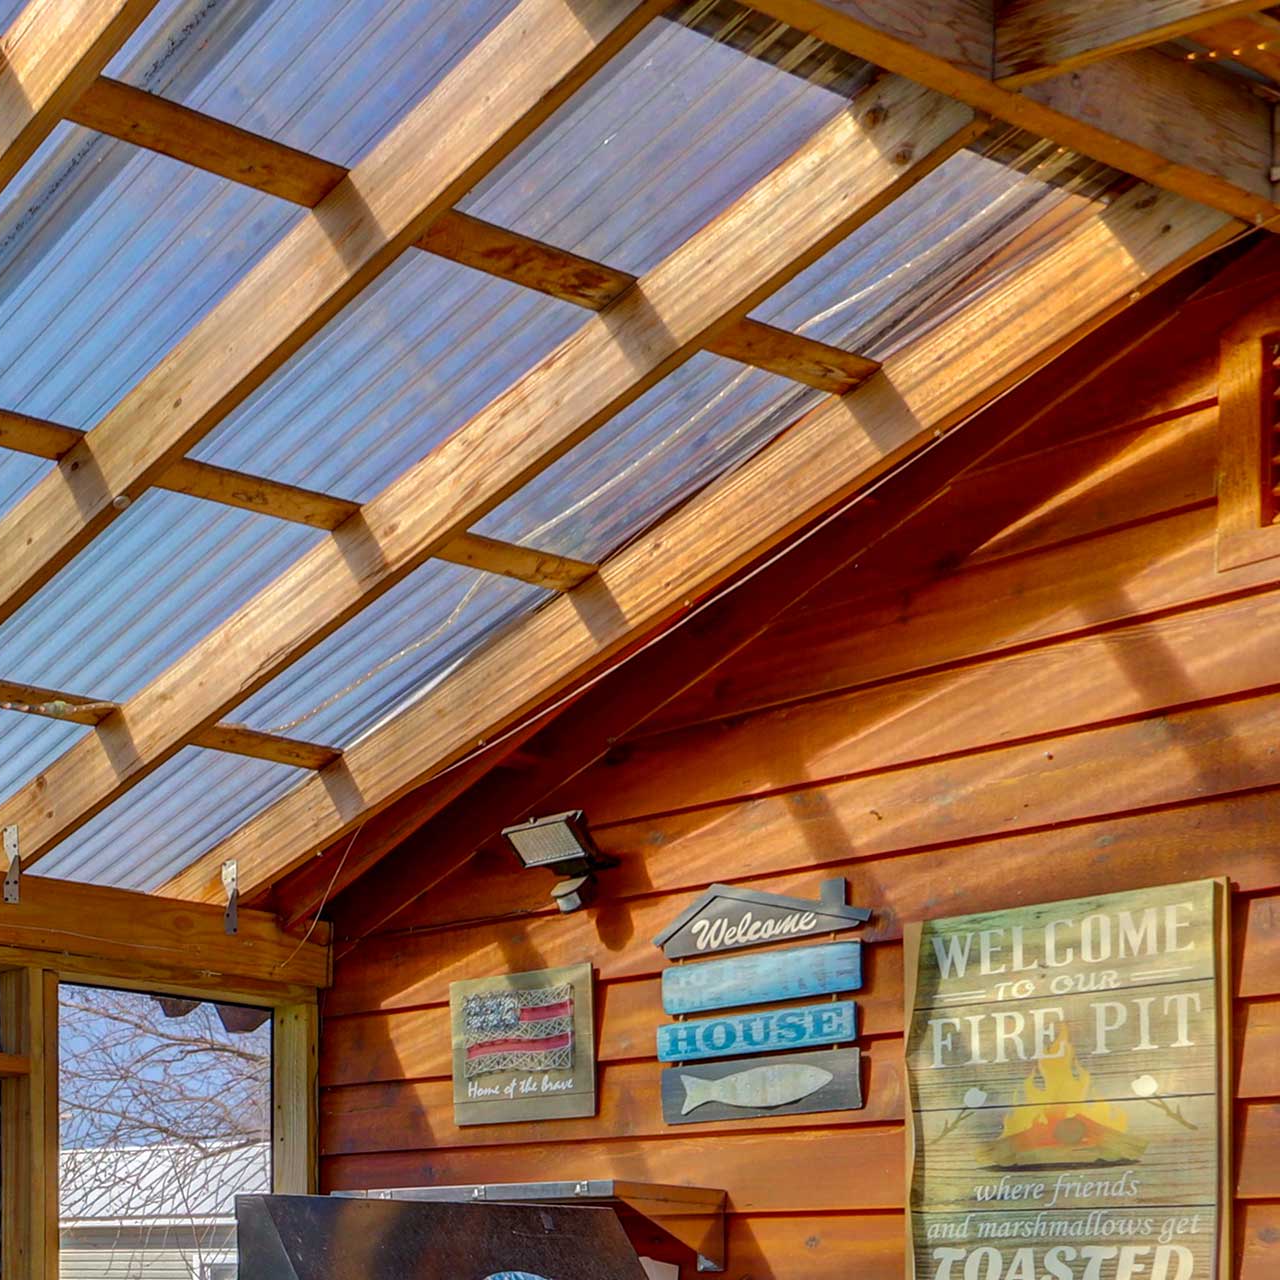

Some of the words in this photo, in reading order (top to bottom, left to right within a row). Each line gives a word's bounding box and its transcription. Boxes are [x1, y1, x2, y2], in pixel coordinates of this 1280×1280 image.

[691, 911, 817, 950] Welcome
[931, 901, 1196, 980] WELCOME
[993, 979, 1036, 1001] TO
[1049, 969, 1122, 995] OUR
[665, 1006, 844, 1056] HOUSE
[927, 1007, 1066, 1069] FIRE
[1090, 992, 1201, 1056] PIT
[468, 1081, 500, 1098] Home
[504, 1078, 518, 1099] of
[519, 1076, 538, 1093] the
[973, 1175, 1045, 1202] where
[1044, 1170, 1140, 1207] friends
[927, 1213, 976, 1240] and
[976, 1210, 1154, 1239] marshmallows
[1157, 1213, 1202, 1244] get
